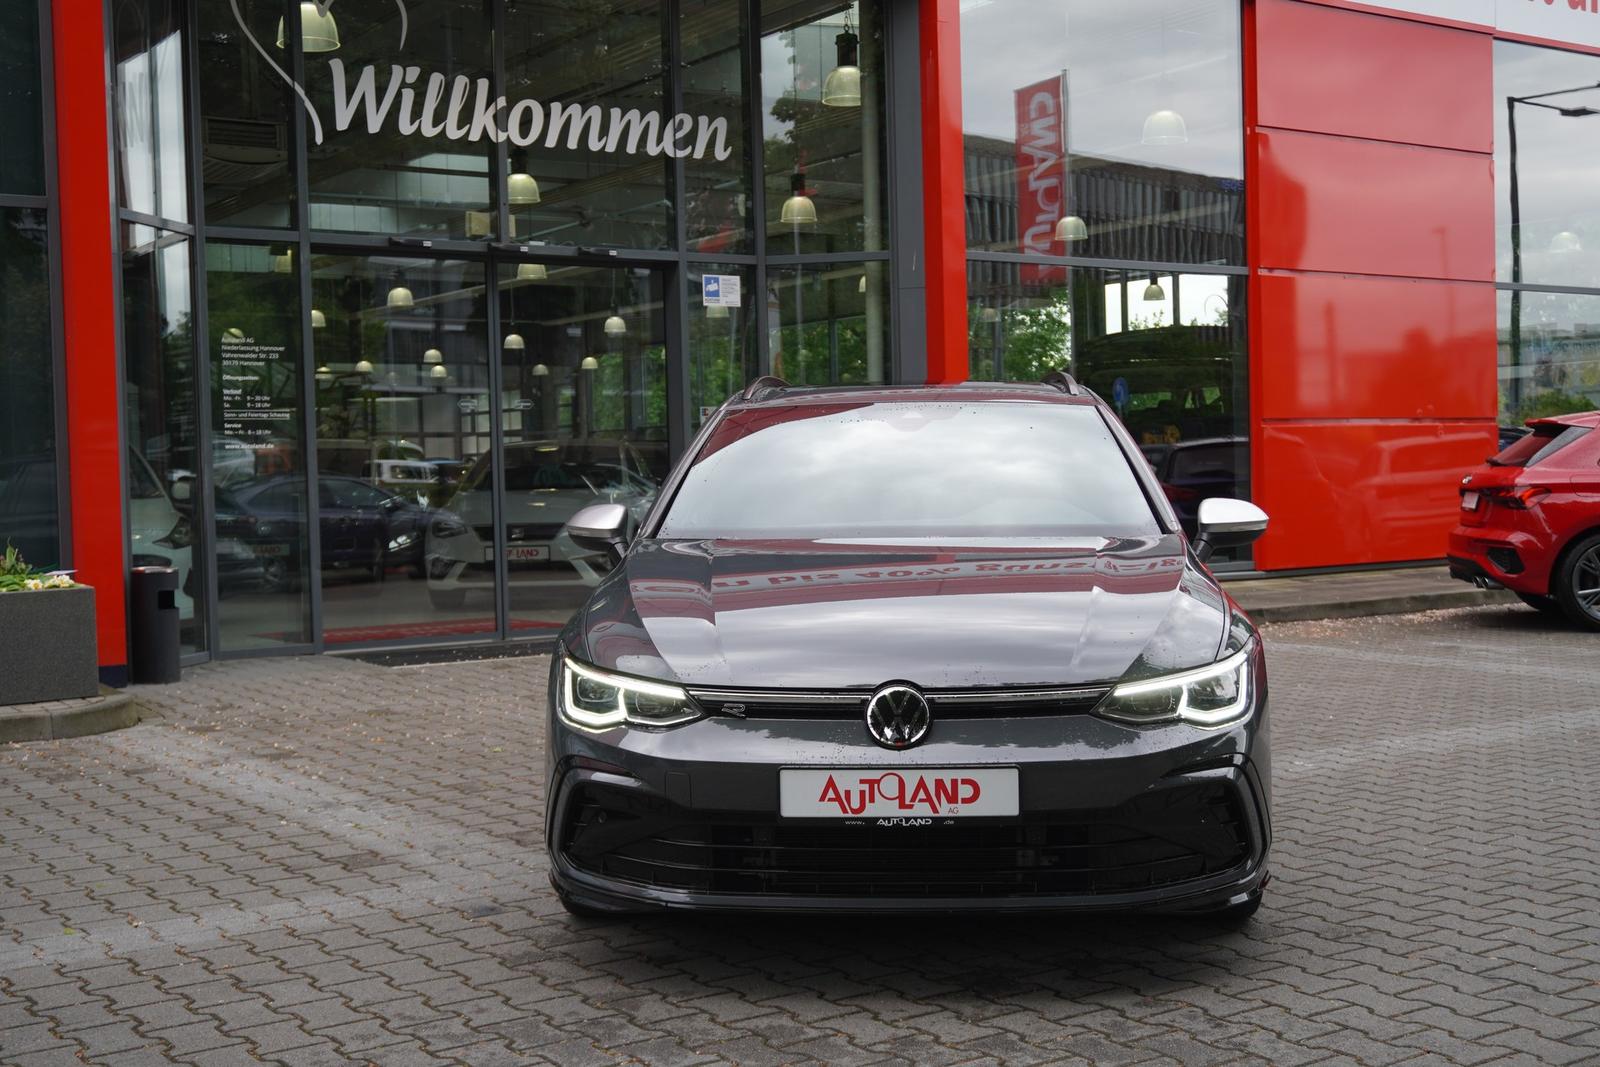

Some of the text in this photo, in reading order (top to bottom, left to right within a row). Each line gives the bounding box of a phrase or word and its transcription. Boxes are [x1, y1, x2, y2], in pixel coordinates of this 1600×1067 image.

[328, 57, 732, 161] Willkommen
[221, 344, 259, 352] Niederlassung
[818, 772, 981, 815] AUTOLAND
[948, 807, 959, 815] AG
[877, 817, 932, 827] AUTOLAND
